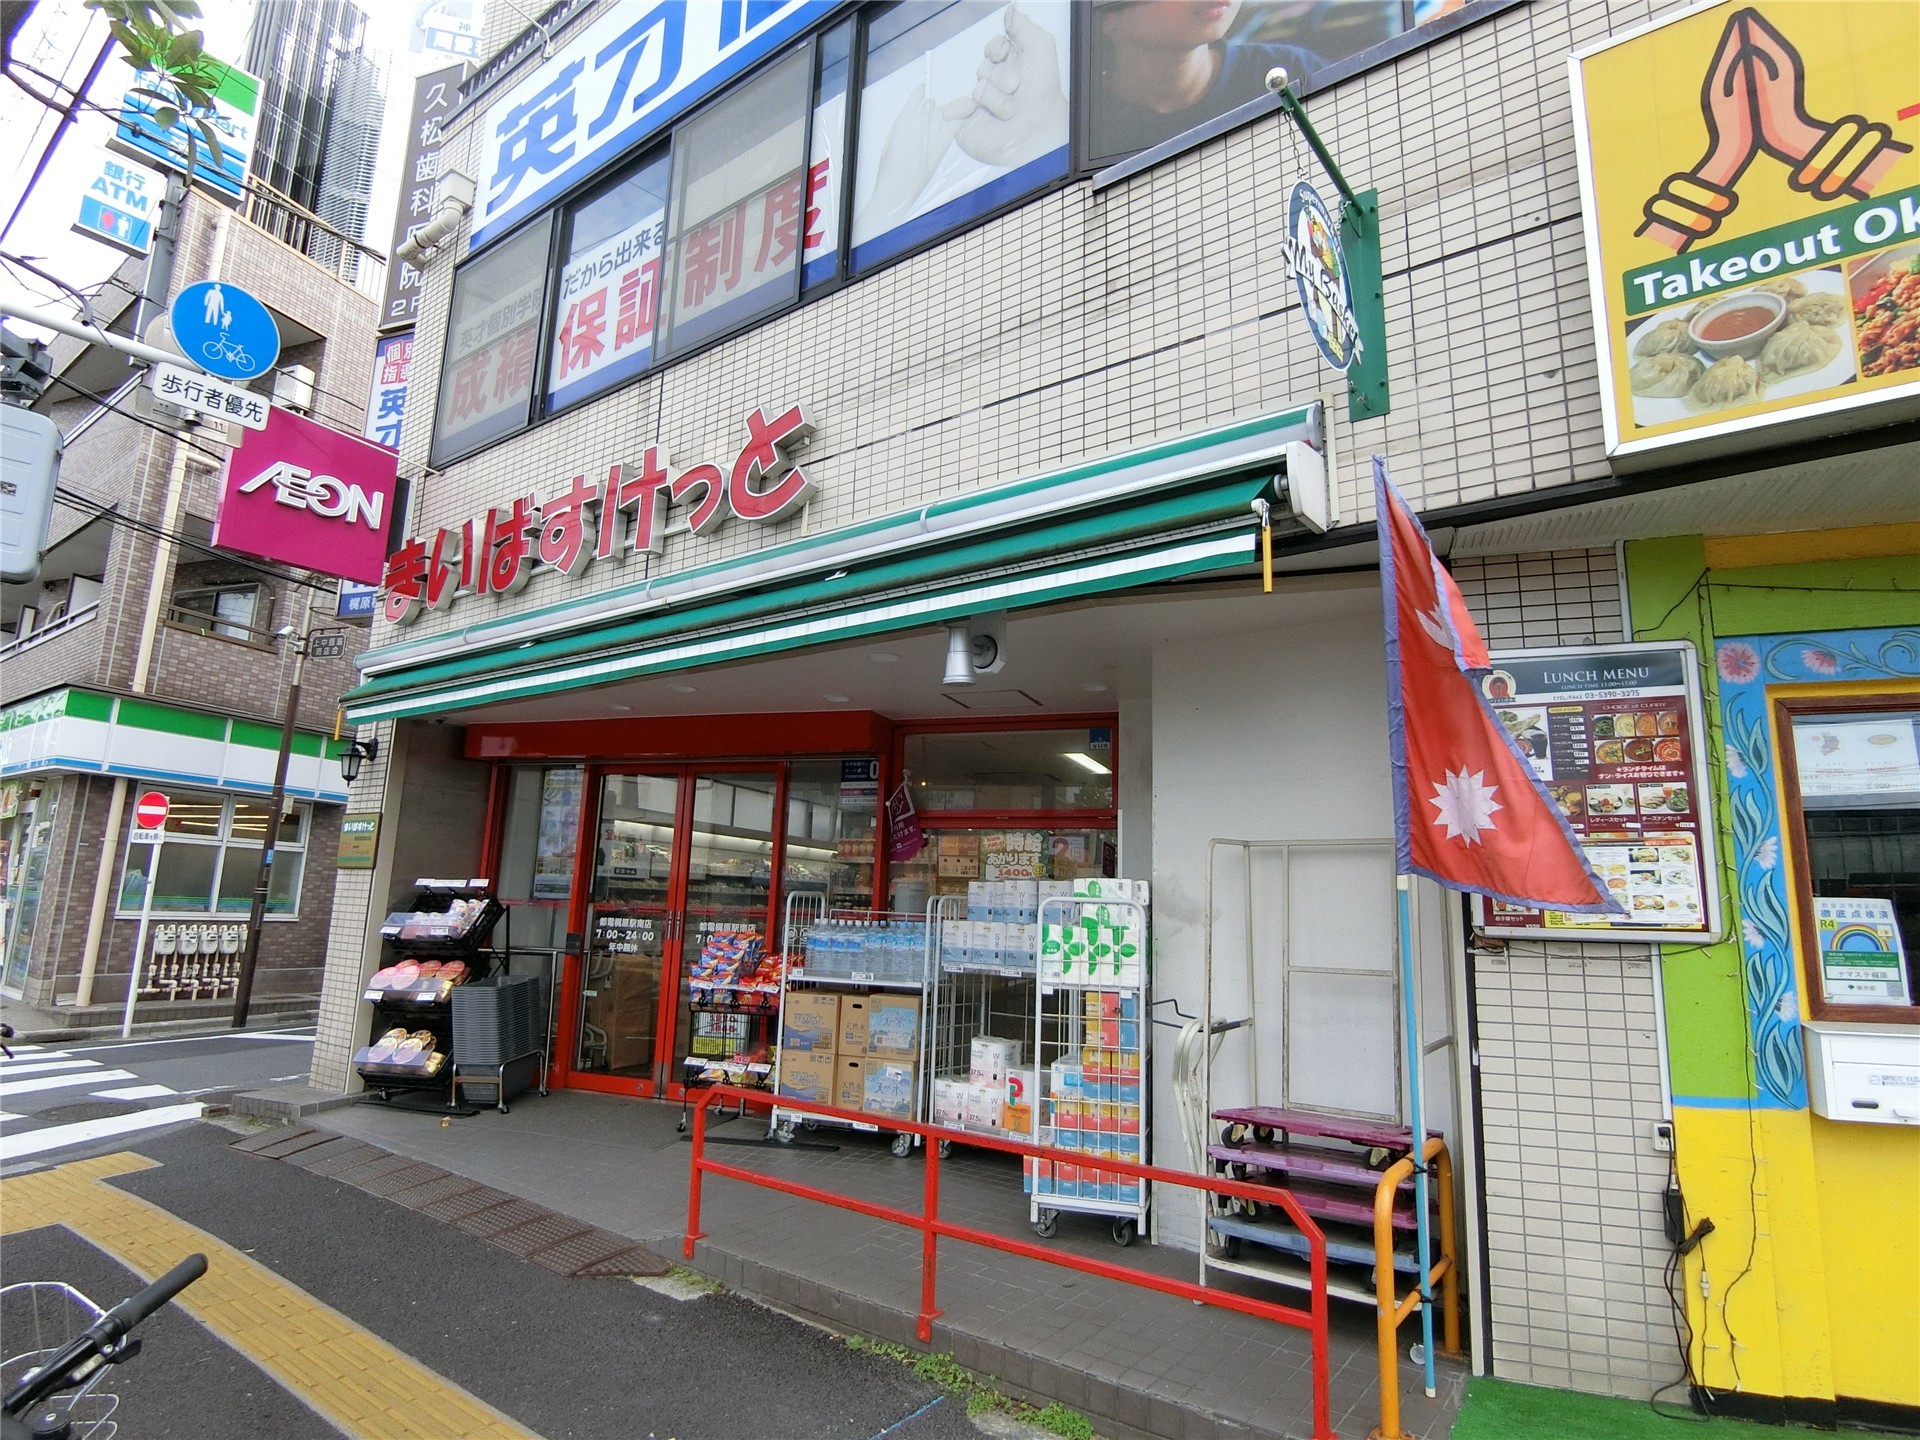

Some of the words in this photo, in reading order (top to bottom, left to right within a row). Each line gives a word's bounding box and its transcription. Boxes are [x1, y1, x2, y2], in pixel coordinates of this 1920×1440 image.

[104, 160, 147, 190] 銀行
[91, 176, 149, 213] ATM
[563, 222, 664, 300] だから出来る
[1633, 220, 1842, 306] Takeout
[161, 374, 265, 423] 歩行者優先
[384, 403, 816, 626] まいばすけっと
[1543, 670, 1597, 684] LUNCH
[1603, 667, 1649, 680] MENU
[1585, 689, 1641, 699] 03-5390-3275
[1005, 832, 1043, 853] 時給
[986, 852, 1042, 866] あがります
[1820, 909, 1889, 919] 徹底点検済
[599, 917, 653, 929] 都電梶原駅南店
[1820, 919, 1835, 929] R4
[962, 931, 968, 939] S
[994, 933, 1000, 941] S
[608, 942, 639, 953] 年中無休
[992, 1052, 1001, 1060] W
[956, 1092, 964, 1100] W
[990, 1097, 999, 1105] W
